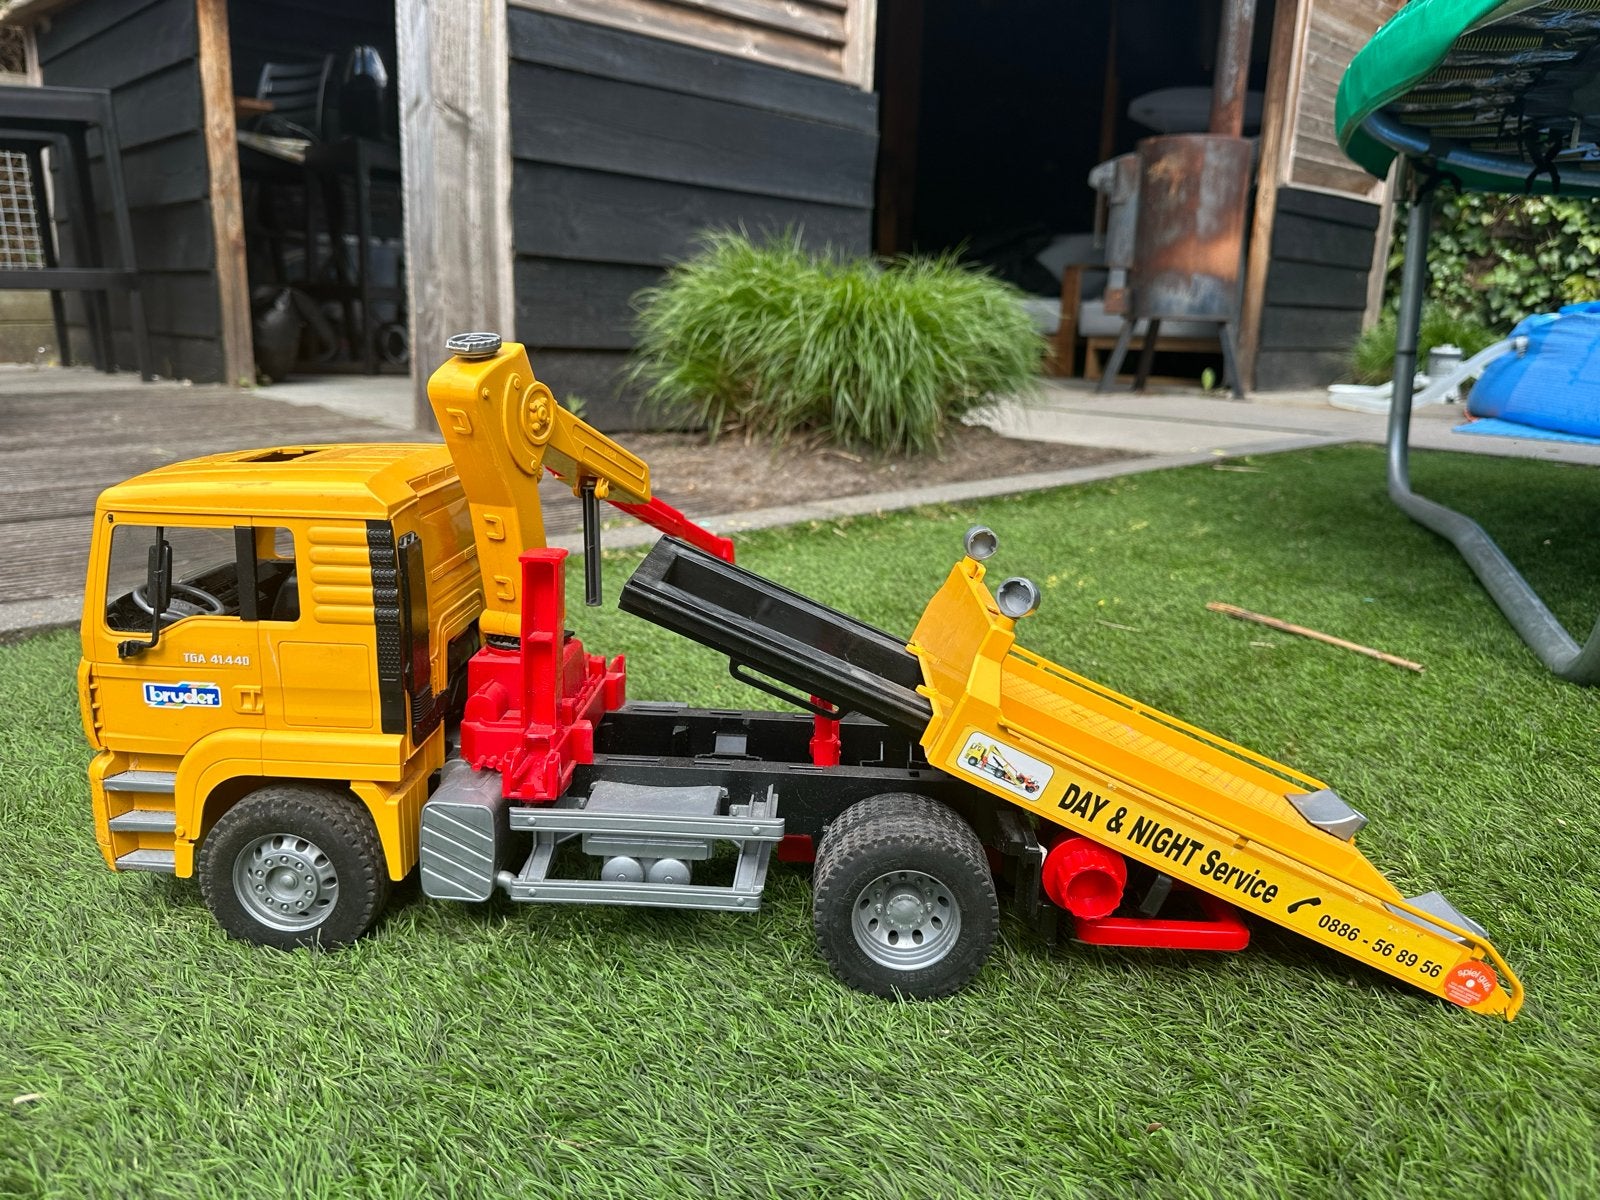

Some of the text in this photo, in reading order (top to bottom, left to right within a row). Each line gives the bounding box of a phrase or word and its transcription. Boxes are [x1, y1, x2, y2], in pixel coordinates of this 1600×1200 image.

[183, 652, 250, 666] TGA 41.440
[148, 685, 216, 705] bruder
[1057, 782, 1279, 904] DAY & NIGHT Service
[1318, 914, 1361, 942] 0886
[1371, 938, 1396, 957] 56
[1395, 949, 1419, 967] 89
[1419, 960, 1443, 979] 56
